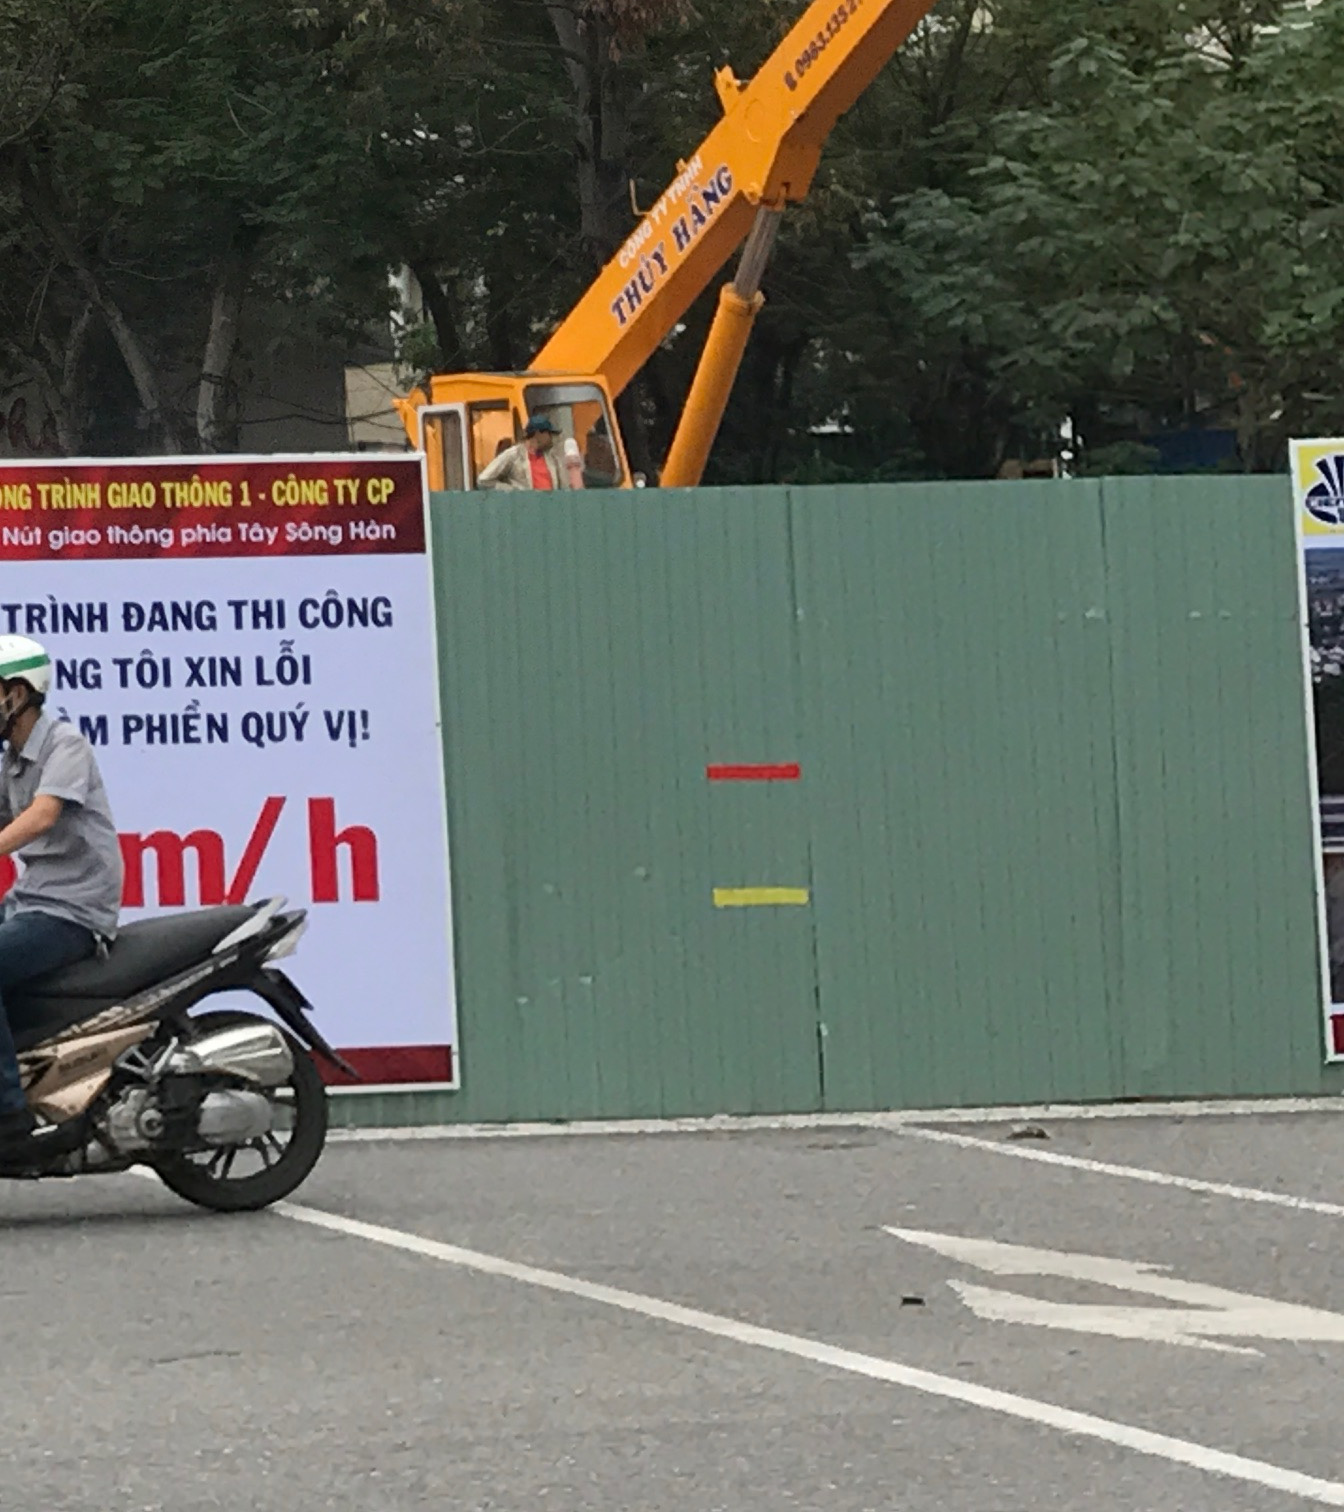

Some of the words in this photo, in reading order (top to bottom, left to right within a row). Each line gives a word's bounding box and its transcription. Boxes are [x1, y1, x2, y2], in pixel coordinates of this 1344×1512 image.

[651, 196, 668, 225] TY
[36, 477, 102, 510] TRÌNH
[107, 481, 156, 509] GIAO
[160, 474, 233, 508] THÔNG
[239, 480, 252, 507] 1
[271, 473, 329, 506] CÔNG
[333, 478, 360, 505] TY
[366, 477, 395, 505] CP
[2, 525, 42, 546] Nút
[47, 525, 102, 550] giao
[106, 524, 175, 549] thông
[180, 522, 232, 547] phía
[237, 522, 279, 546] Tây
[284, 521, 343, 546] Sông
[349, 519, 396, 541] Hàn
[0, 595, 109, 634] TRÌNH
[121, 599, 217, 632] ĐANG
[227, 599, 286, 631] THI
[298, 589, 393, 629] CÔNG
[112, 648, 172, 689] TÔI
[184, 656, 242, 688] XIN
[255, 639, 312, 686] LỖI
[122, 698, 229, 745] PHIỀN
[241, 702, 310, 749] QUÝ
[323, 709, 370, 748] VỊ!
